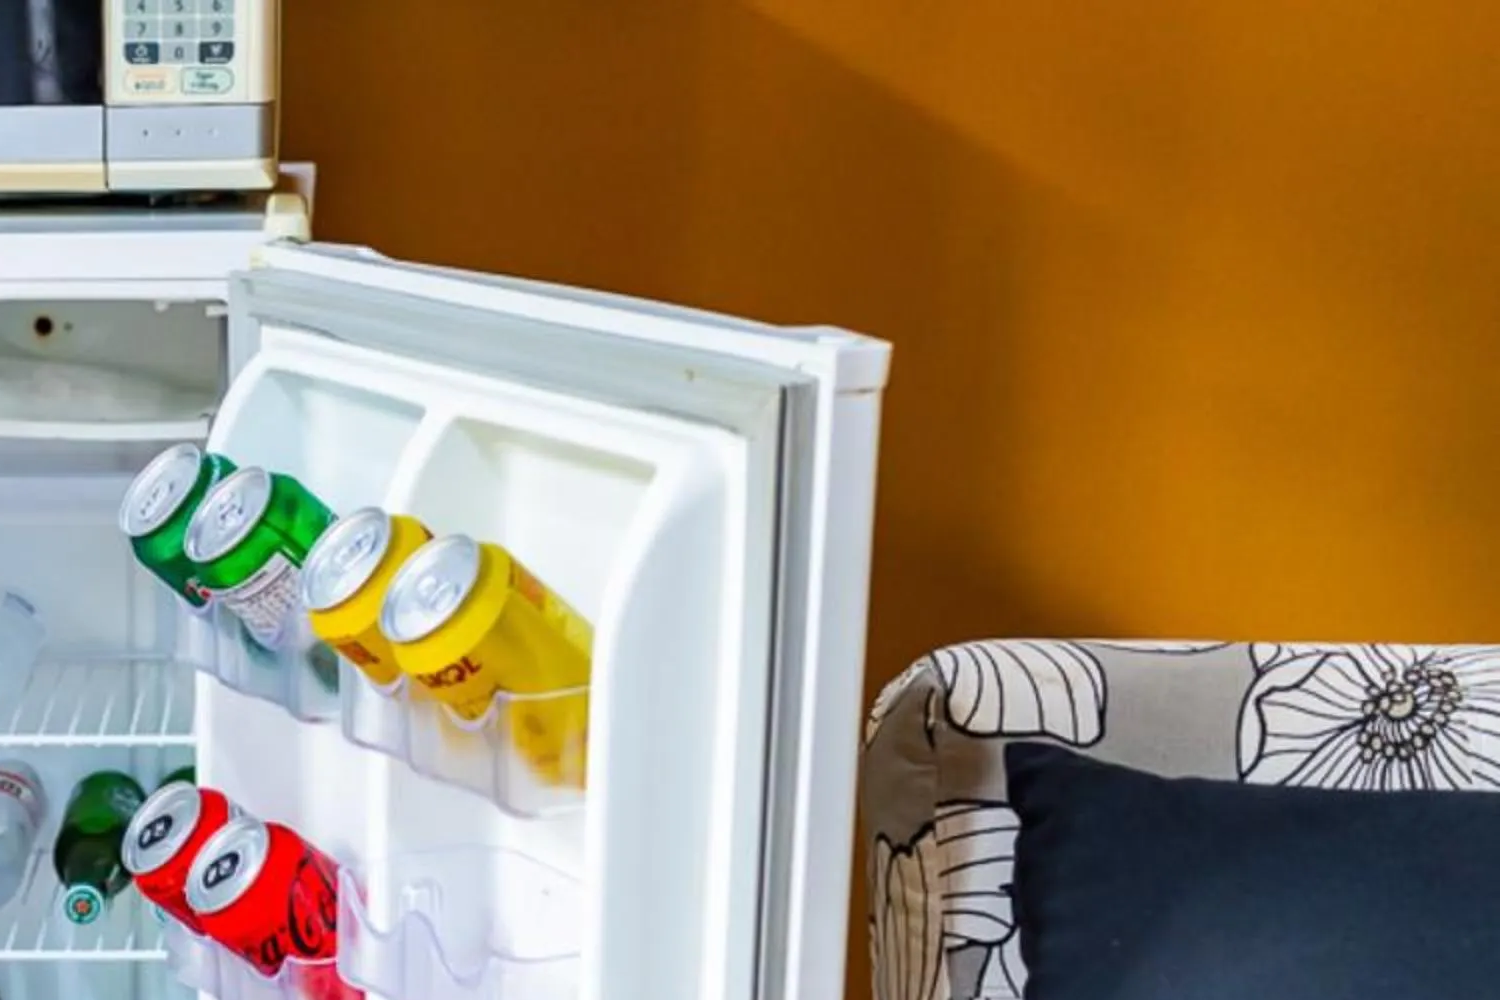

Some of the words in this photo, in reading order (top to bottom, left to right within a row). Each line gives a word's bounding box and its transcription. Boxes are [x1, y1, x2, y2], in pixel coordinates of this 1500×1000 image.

[137, 20, 147, 37] 7
[174, 20, 184, 37] 8
[211, 20, 223, 37] 9
[173, 45, 185, 60] 0
